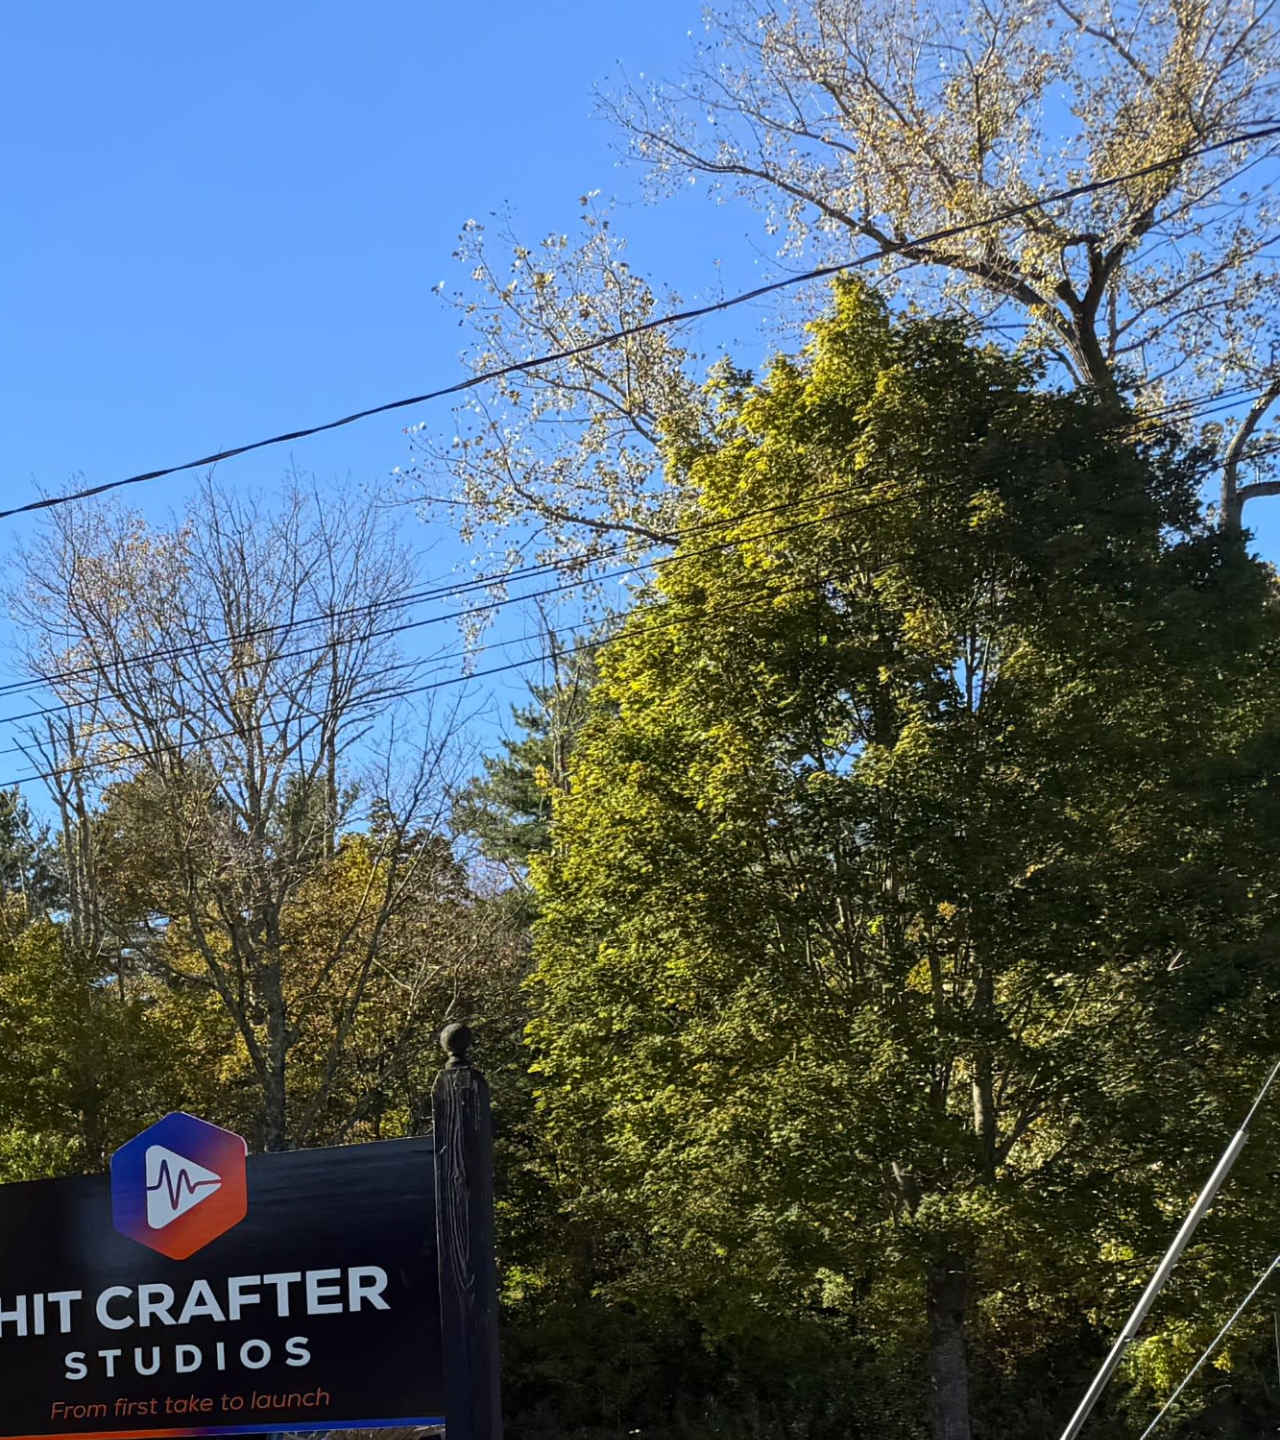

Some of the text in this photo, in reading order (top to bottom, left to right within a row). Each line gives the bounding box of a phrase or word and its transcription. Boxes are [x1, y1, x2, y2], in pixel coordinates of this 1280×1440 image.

[96, 1265, 392, 1331] CRAFTER
[64, 1336, 312, 1381] STUDIOS
[50, 1387, 331, 1421] From first take to launch
